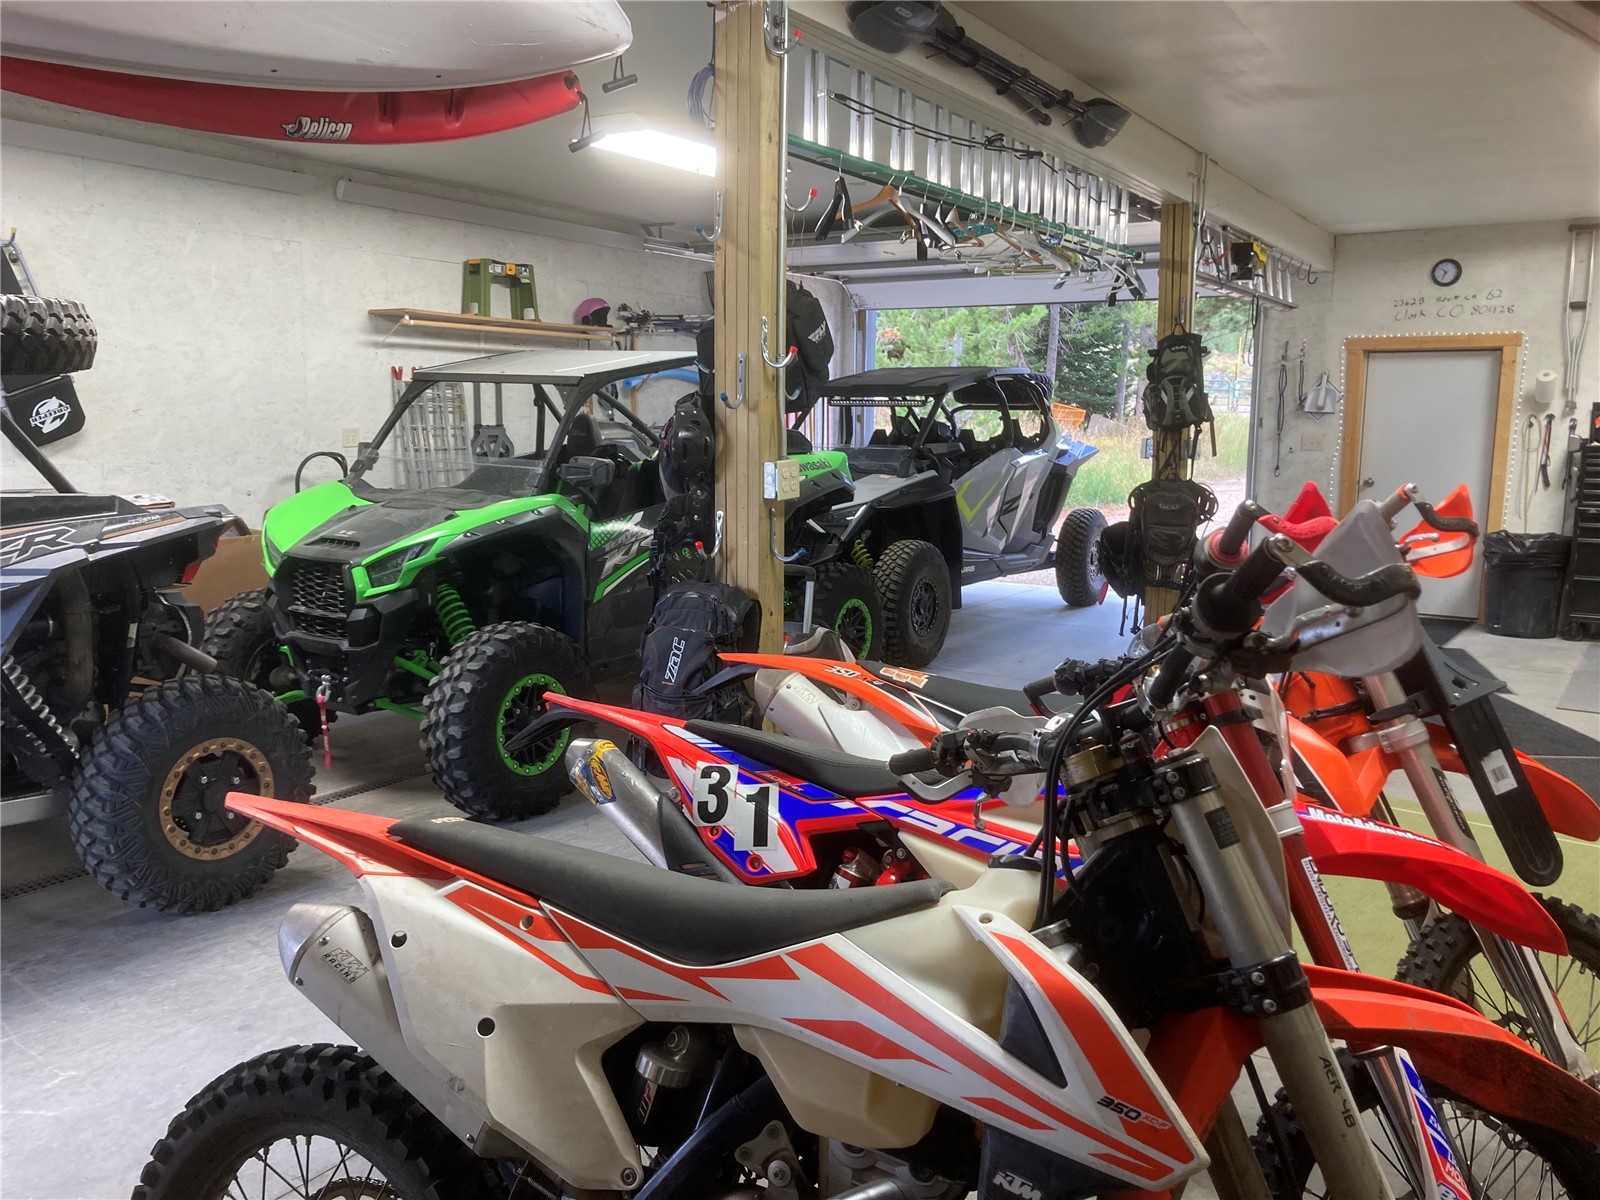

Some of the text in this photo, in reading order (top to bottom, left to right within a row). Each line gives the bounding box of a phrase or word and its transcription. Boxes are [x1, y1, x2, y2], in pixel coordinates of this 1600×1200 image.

[299, 116, 353, 140] Pelican
[1486, 289, 1503, 300] 62
[1436, 304, 1464, 318] CO
[31, 405, 71, 424] CREEPER
[323, 953, 357, 983] RACING
[330, 947, 370, 979] KTM
[1319, 1056, 1342, 1094] AER
[1097, 1095, 1142, 1121] 350
[993, 1171, 1041, 1200] KTM
